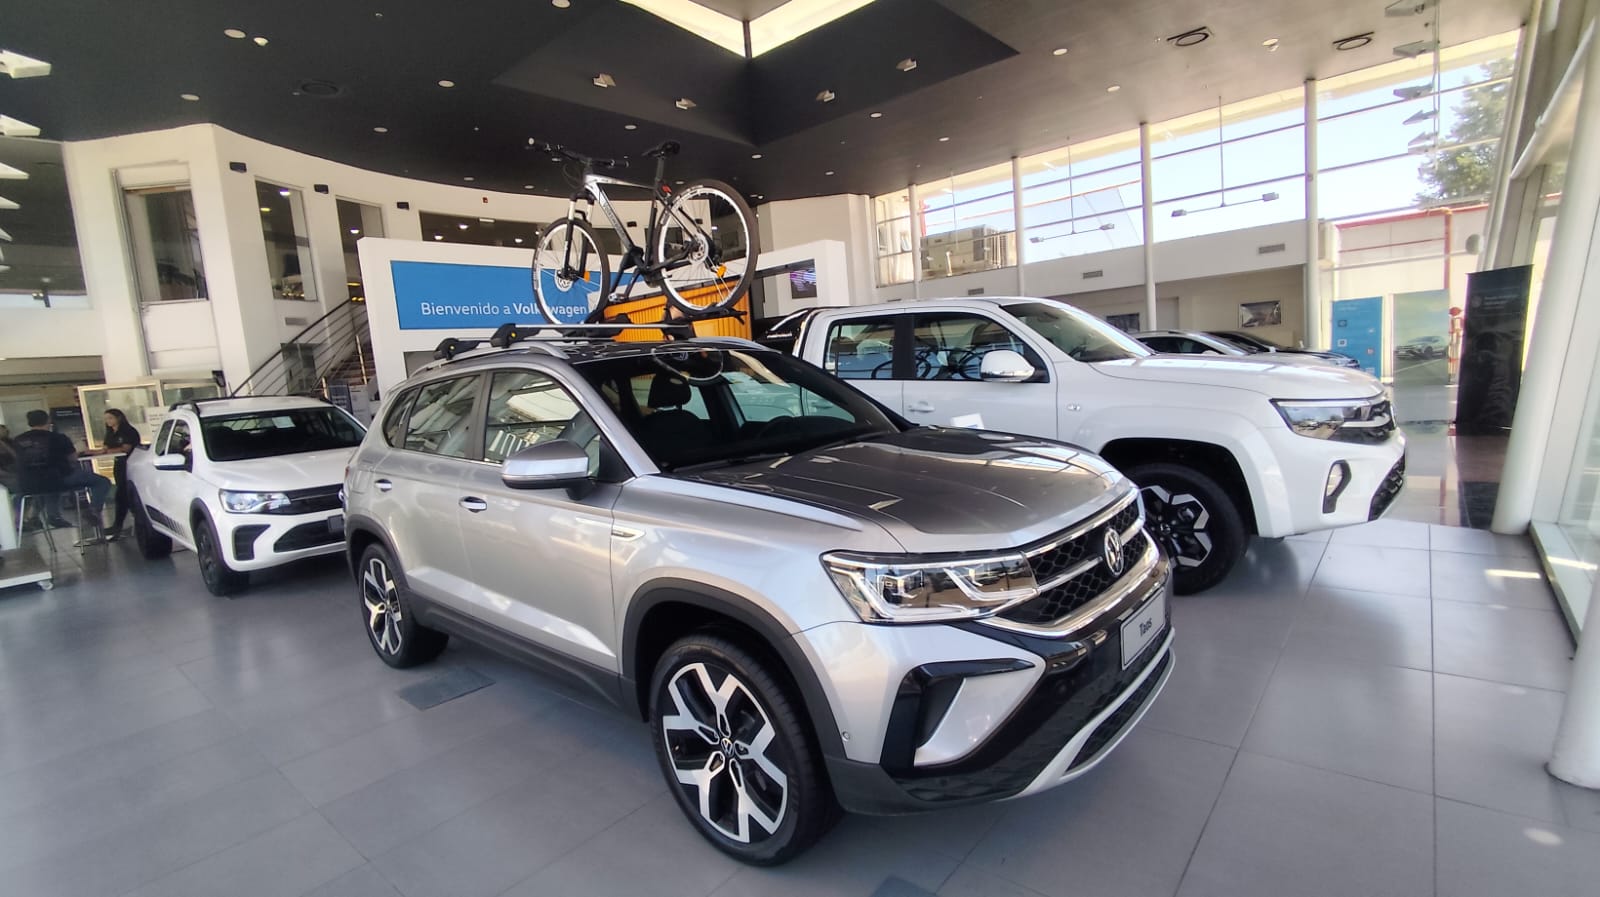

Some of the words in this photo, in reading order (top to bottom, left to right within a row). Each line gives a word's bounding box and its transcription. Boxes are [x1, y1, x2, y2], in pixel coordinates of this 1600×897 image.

[421, 302, 499, 315] Bienvenido
[503, 305, 511, 315] a
[512, 302, 587, 317] Volkwagen
[1139, 617, 1152, 636] Taos
